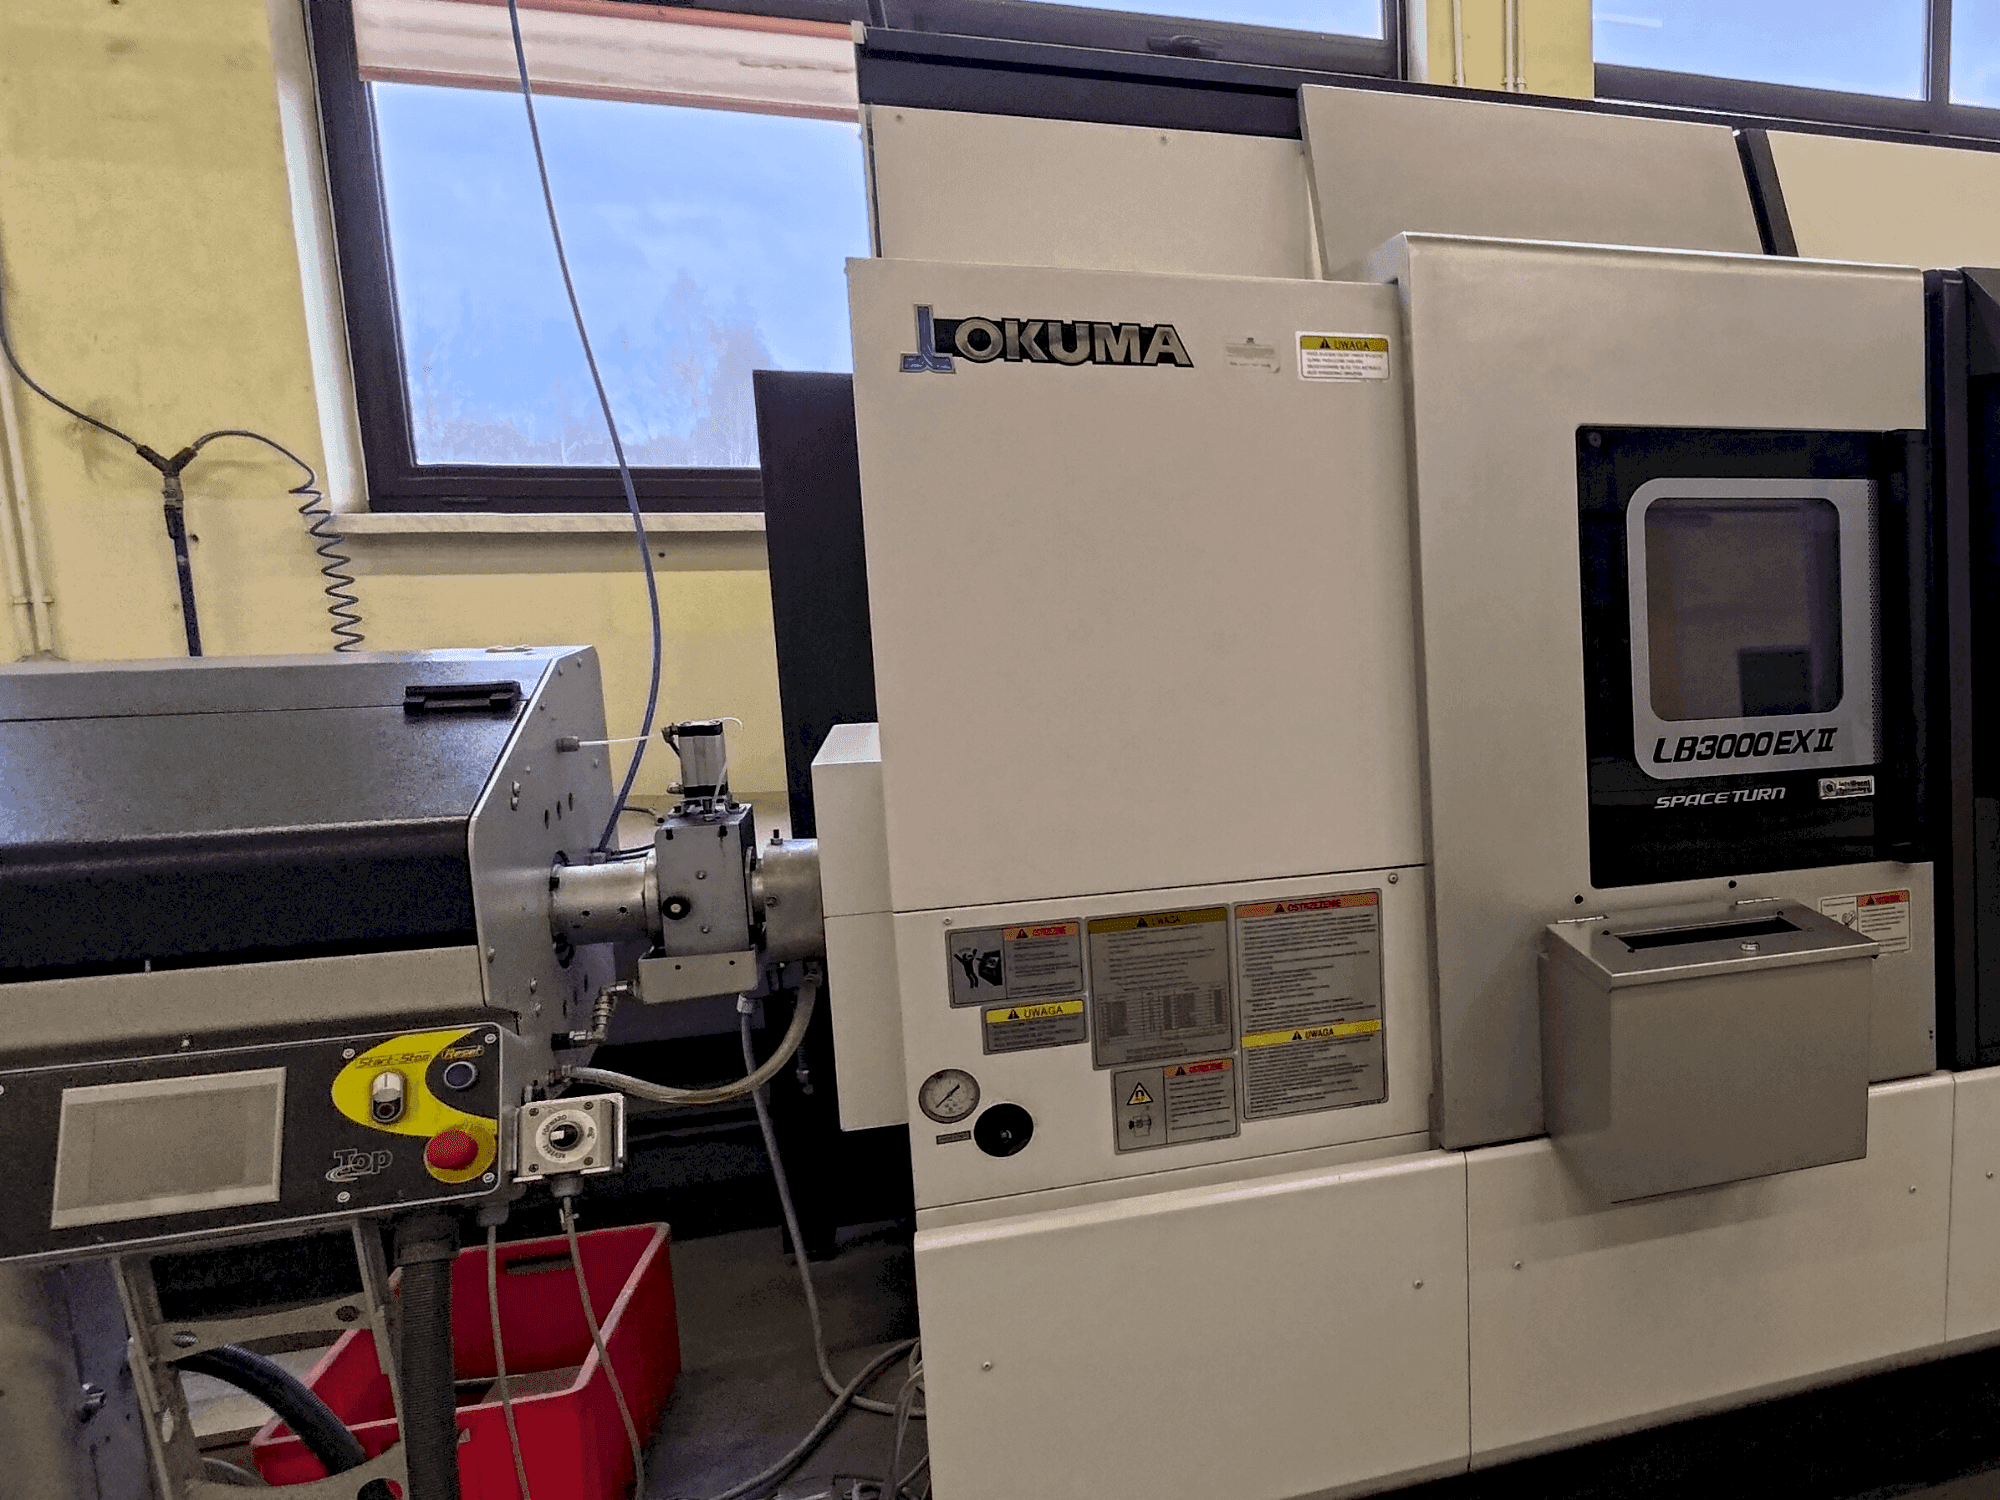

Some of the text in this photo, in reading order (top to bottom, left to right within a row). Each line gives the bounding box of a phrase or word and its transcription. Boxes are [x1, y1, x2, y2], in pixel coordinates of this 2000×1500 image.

[953, 316, 1194, 368] OKUMA
[1334, 339, 1370, 351] UWAGA
[1023, 1006, 1064, 1018] UWAGA
[1305, 1028, 1334, 1040] UWAGA
[445, 1045, 484, 1059] Reset
[541, 1114, 568, 1136] FORWARD
[334, 1148, 393, 1175] Top
